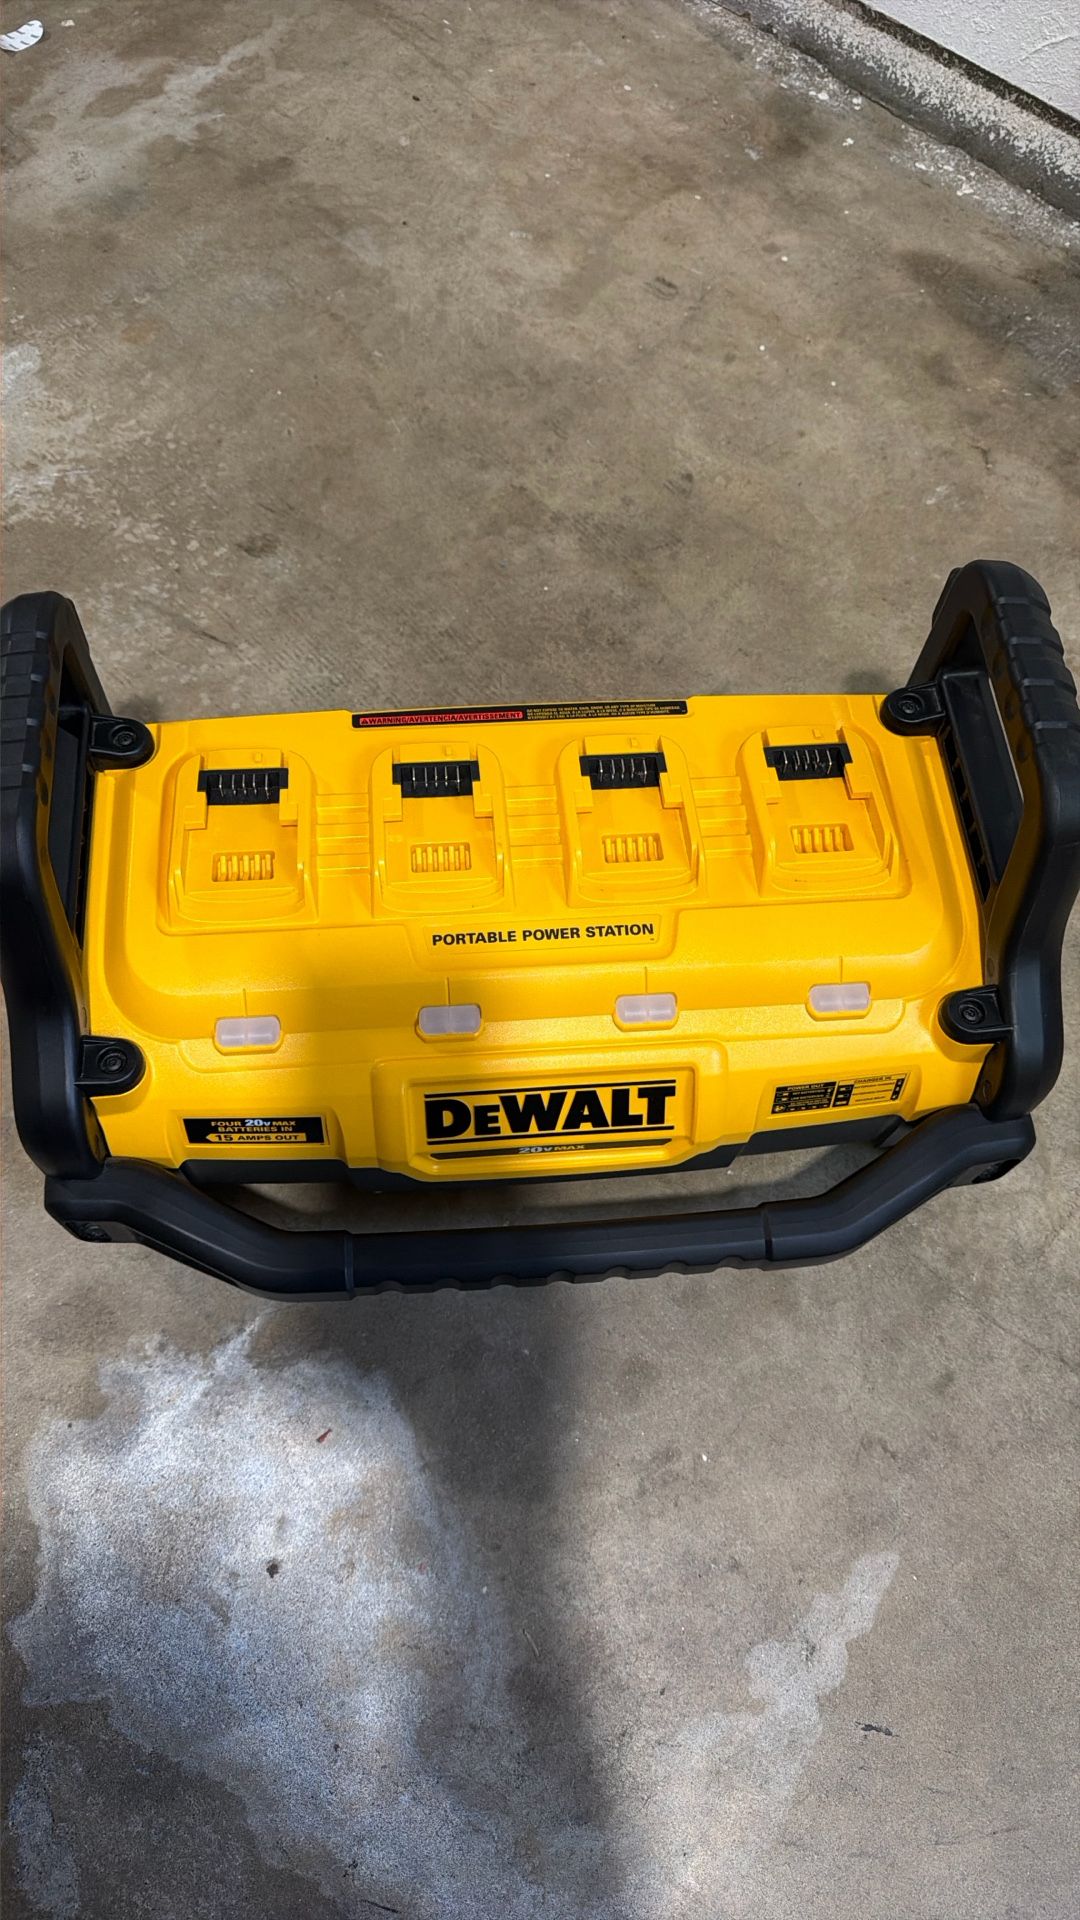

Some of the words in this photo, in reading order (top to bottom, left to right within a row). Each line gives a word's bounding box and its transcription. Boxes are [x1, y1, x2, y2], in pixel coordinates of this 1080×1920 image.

[432, 930, 517, 946] PORTABLE
[522, 927, 581, 942] POWER
[585, 923, 655, 938] STATION
[424, 1085, 676, 1140] DEWALT
[215, 1134, 233, 1142] 15
